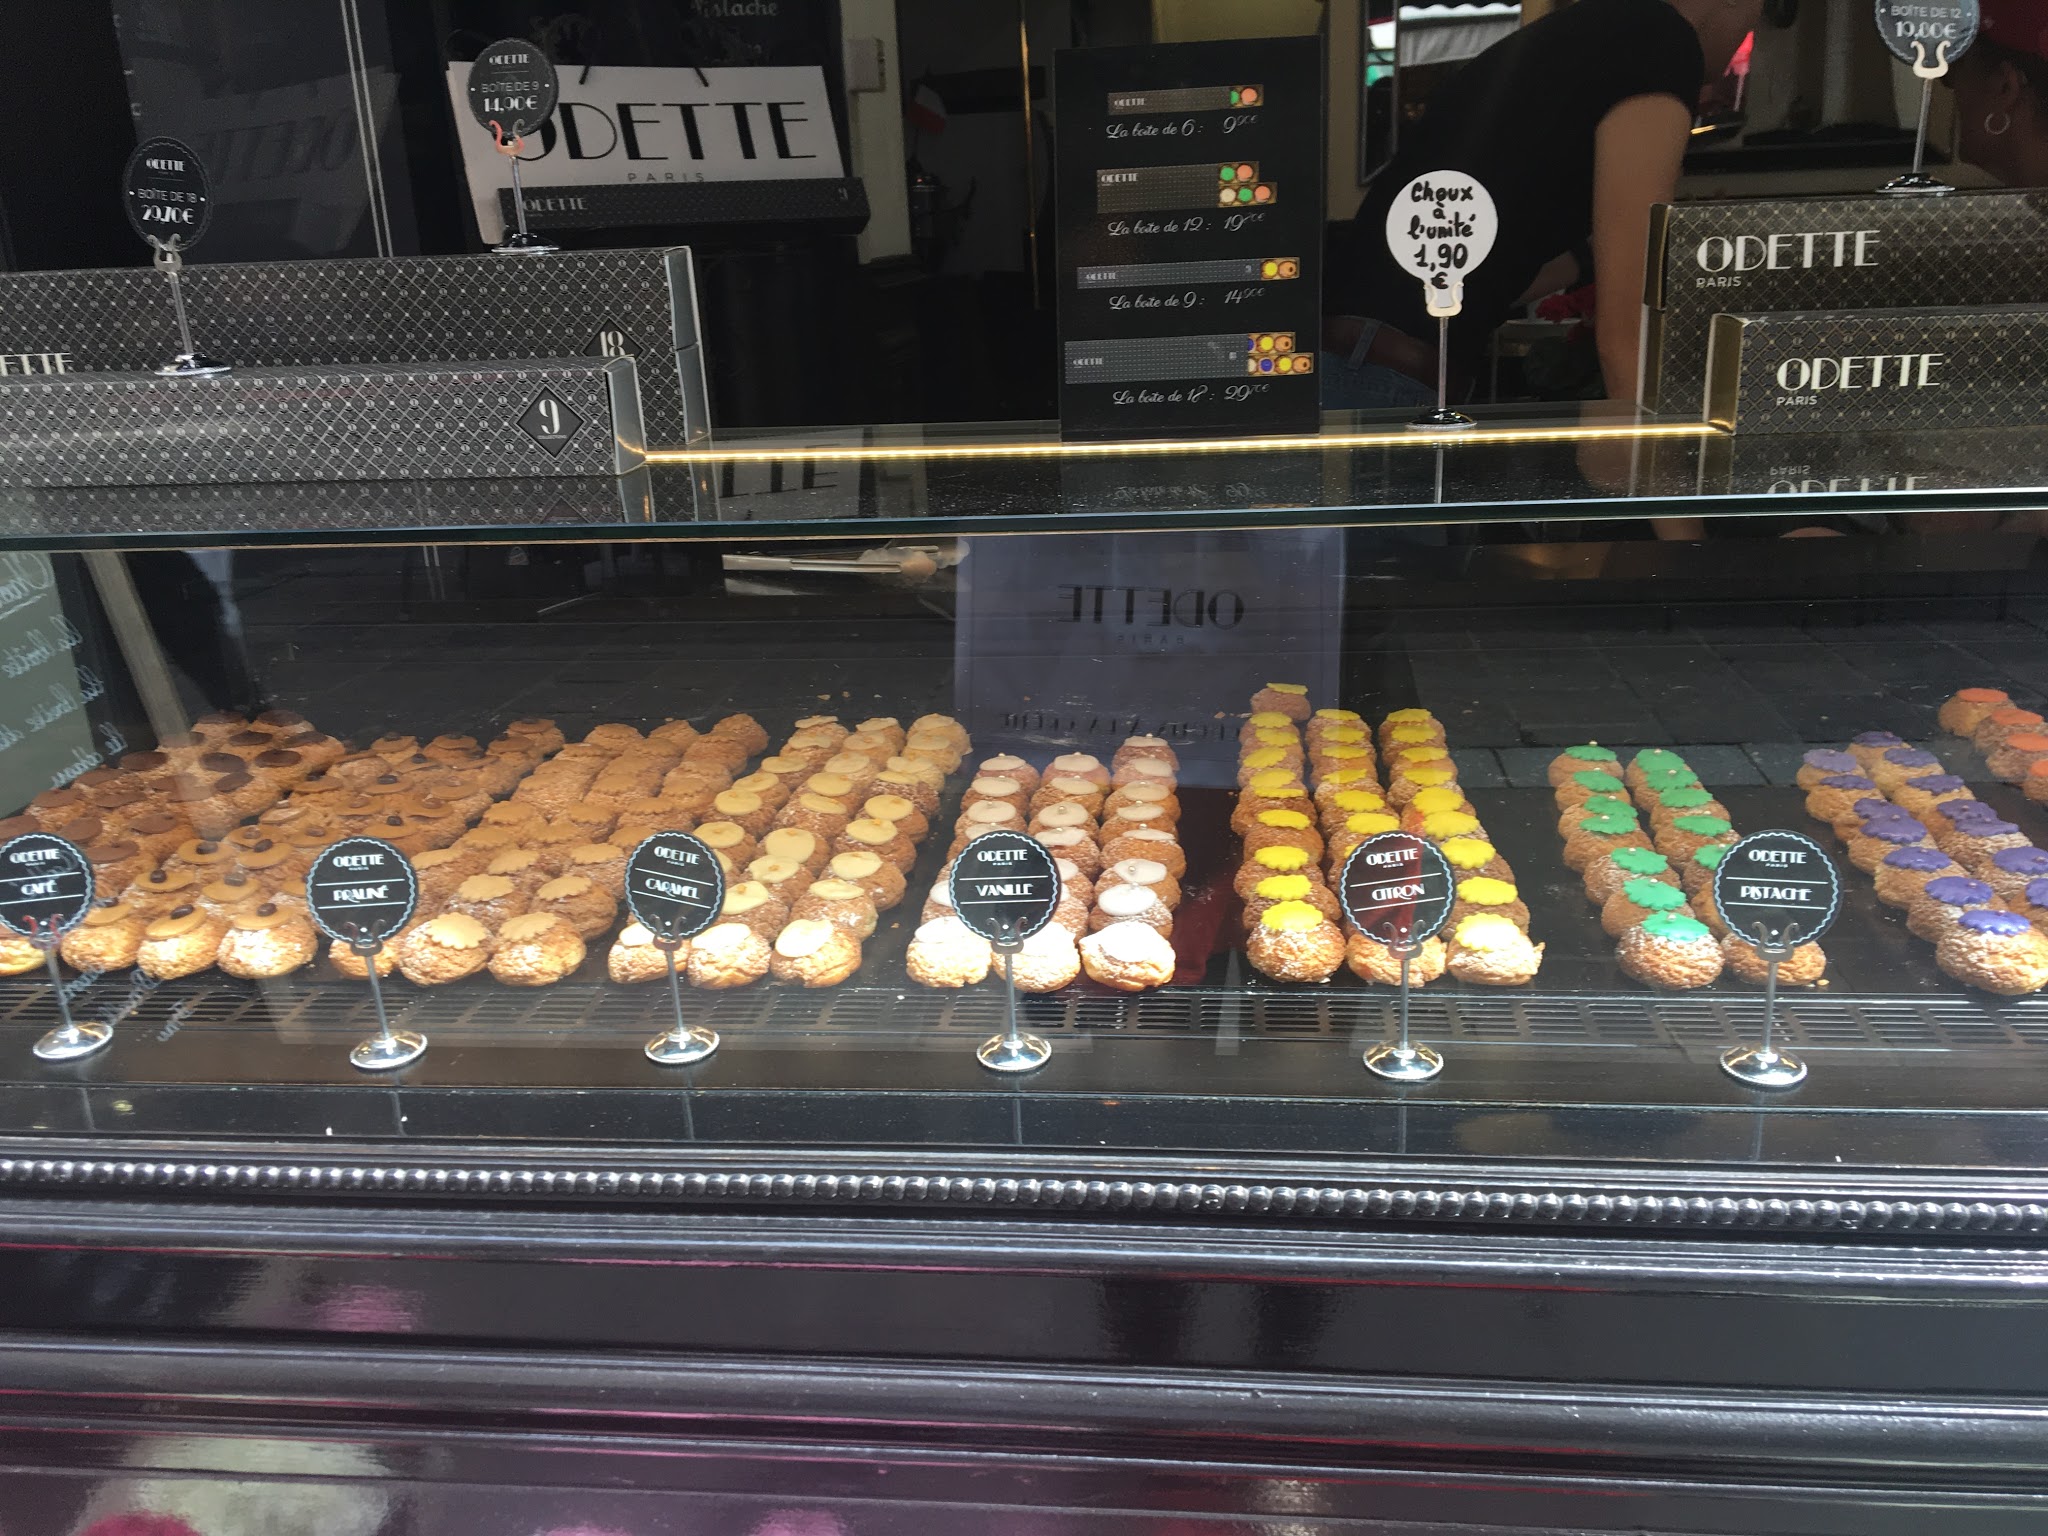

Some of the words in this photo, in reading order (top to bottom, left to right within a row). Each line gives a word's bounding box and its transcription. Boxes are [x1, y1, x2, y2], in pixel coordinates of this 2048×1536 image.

[1930, 8, 1948, 18] DE
[1950, 9, 1961, 18] 12
[1106, 123, 1128, 139] La
[1162, 122, 1178, 135] de
[1181, 118, 1196, 136] 6
[628, 172, 705, 183] PARIS
[170, 191, 184, 203] DE
[1411, 180, 1473, 202] Choux
[1433, 201, 1446, 219] à
[1107, 220, 1130, 236] La
[1163, 219, 1179, 232] de
[1182, 216, 1204, 232] 12
[1407, 211, 1476, 240] l'unité
[1413, 243, 1468, 272] 1,90
[1697, 230, 1880, 272] ODETTE
[1430, 271, 1449, 290] €
[1696, 276, 1742, 288] PARIS
[1109, 294, 1131, 310] La
[1164, 294, 1180, 307] de
[1183, 291, 1197, 308] 9
[600, 330, 626, 358] 18
[1777, 353, 1944, 391] ODETTE
[1112, 389, 1135, 405] La
[1167, 389, 1183, 402] de
[1776, 395, 1818, 406] PARIS
[538, 398, 560, 435] 9
[9, 848, 60, 864] ODETTE
[333, 854, 385, 868] ODETTE
[654, 846, 700, 865] ODETTE
[976, 849, 1028, 862] ODETTE
[1366, 848, 1419, 866] ODETTE
[1748, 849, 1807, 864] ODETTE
[21, 879, 58, 896] CAFÉ
[333, 884, 389, 904] PRALINÉ
[645, 878, 700, 900] CARAMEL
[975, 883, 1034, 897] VANILLE
[1371, 883, 1426, 901] CITRON
[1740, 885, 1813, 902] PISTACHE
